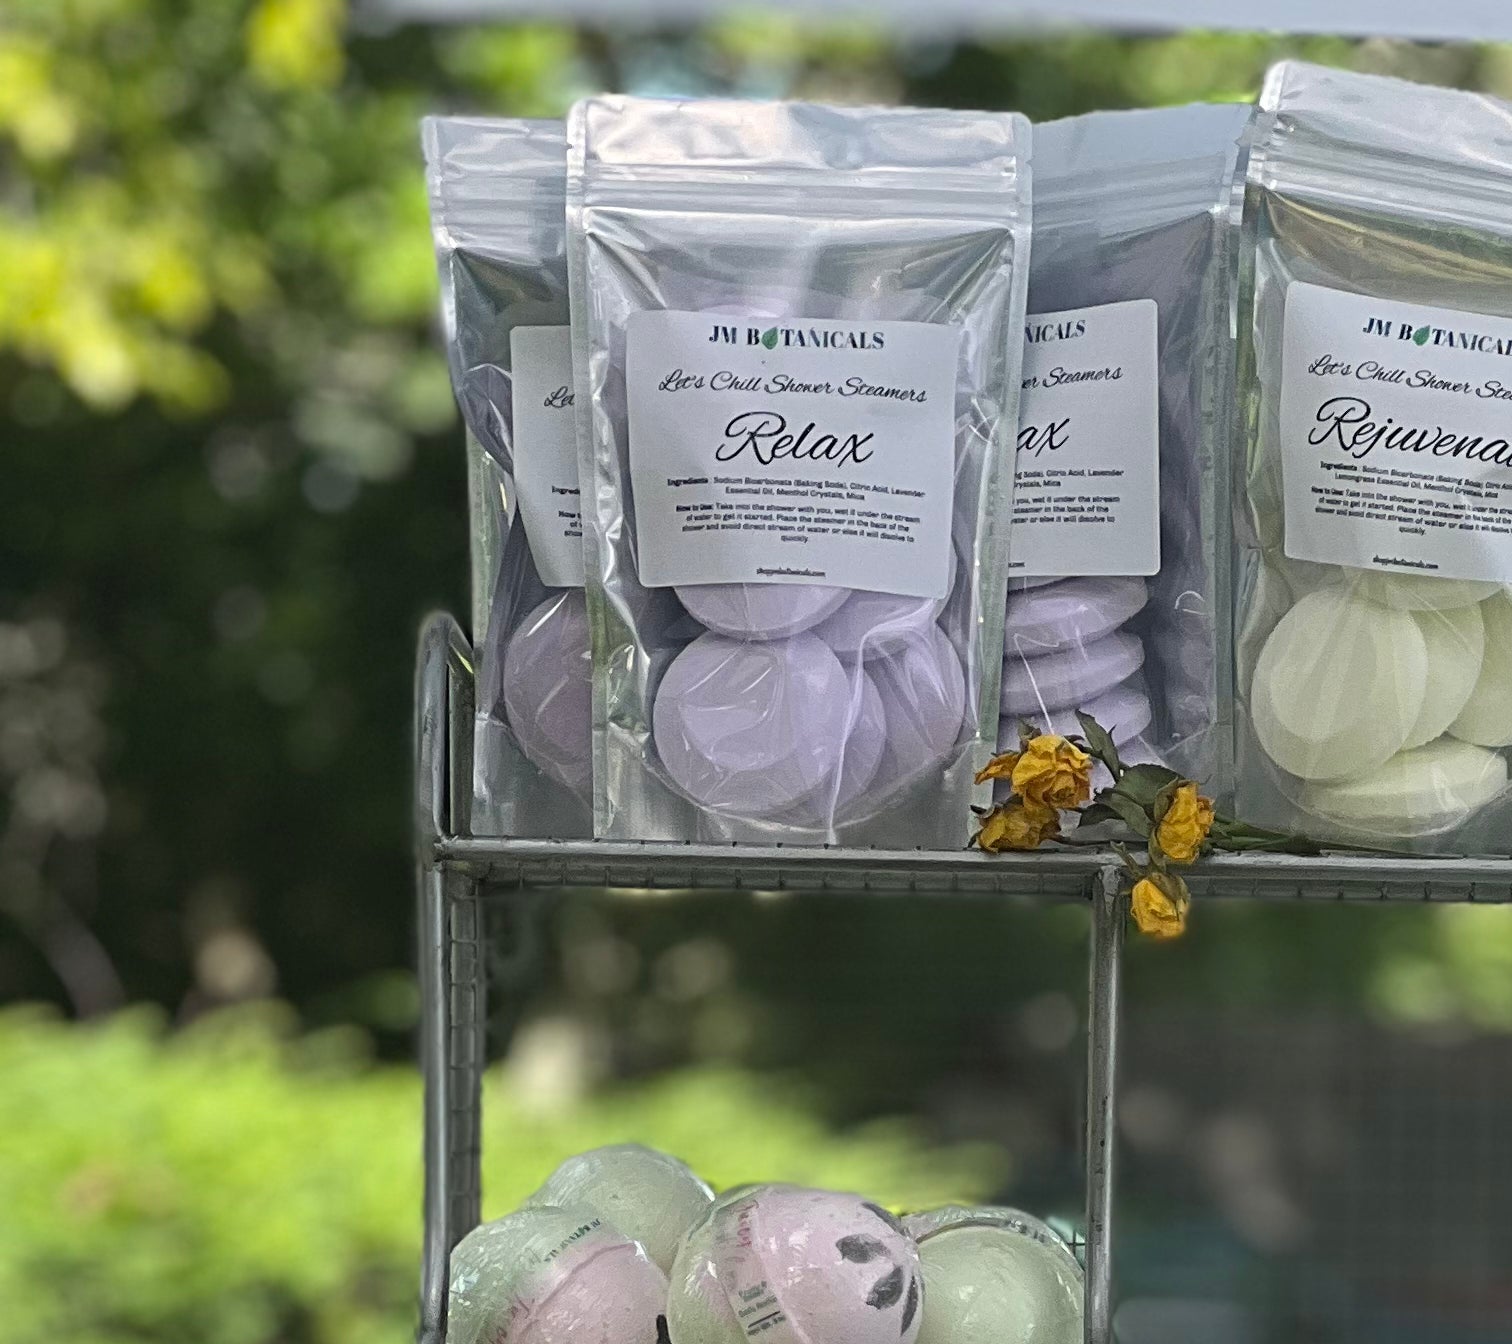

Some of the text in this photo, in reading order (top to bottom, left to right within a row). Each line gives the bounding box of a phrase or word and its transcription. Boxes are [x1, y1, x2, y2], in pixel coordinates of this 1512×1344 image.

[709, 325, 738, 345] JM
[1362, 317, 1393, 338] JM
[709, 371, 761, 395] Chill
[764, 374, 834, 397] Shower
[838, 377, 928, 404] Steamers
[1041, 366, 1123, 389] Steamers
[1355, 361, 1403, 384] Chill
[1405, 369, 1473, 396] Shower
[715, 411, 875, 468] Relax
